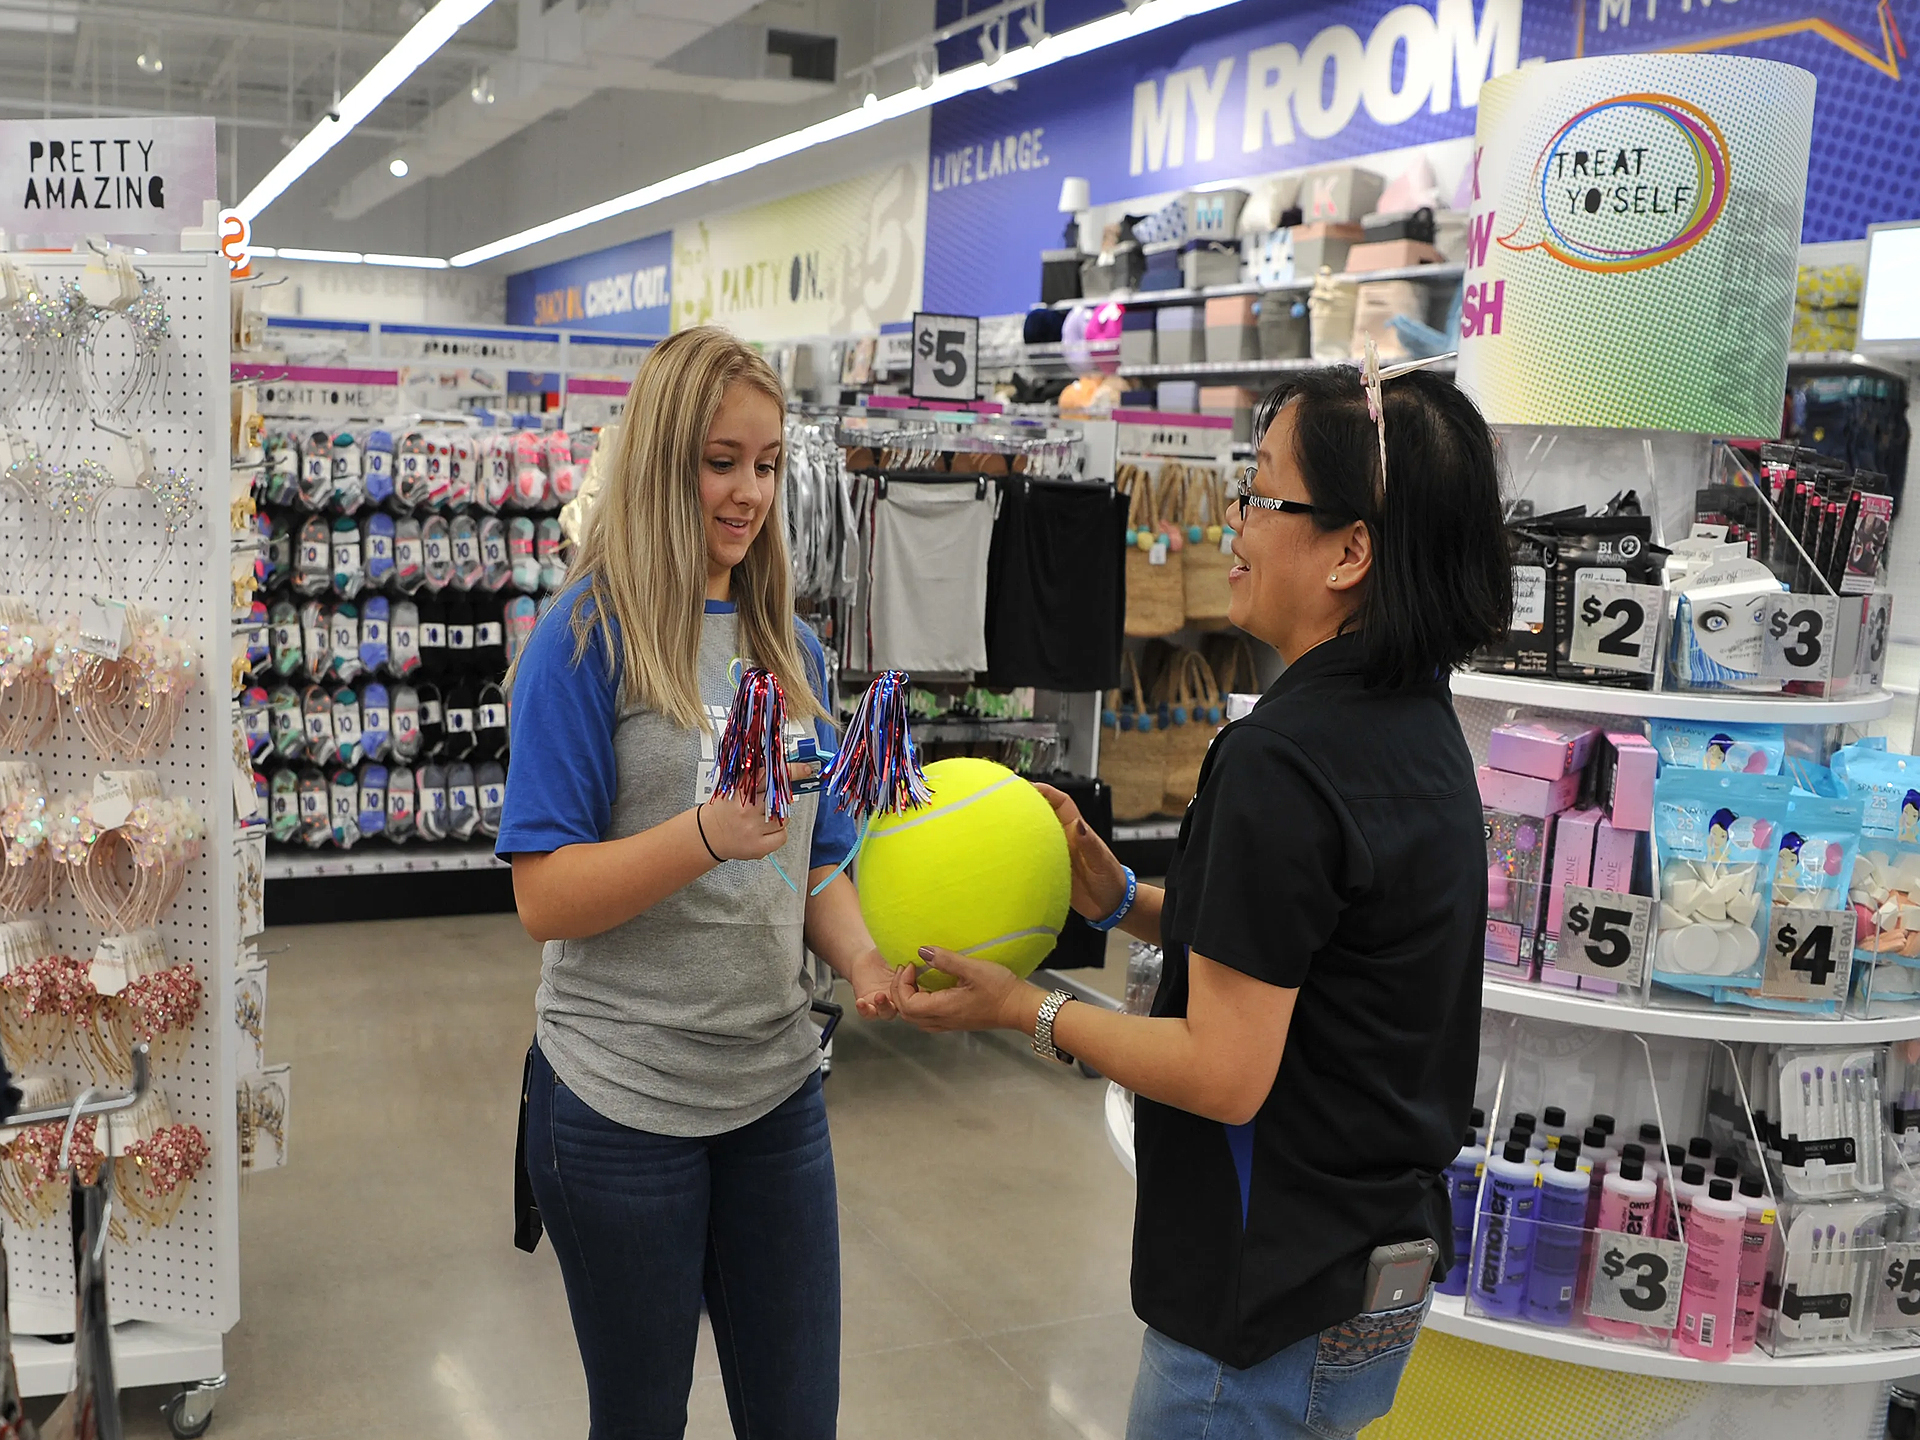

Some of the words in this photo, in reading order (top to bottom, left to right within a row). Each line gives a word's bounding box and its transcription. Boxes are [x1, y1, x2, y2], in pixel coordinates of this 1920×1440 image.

[1129, 58, 1236, 177] MY
[29, 139, 153, 173] PRETTY
[932, 146, 973, 191] LIVE
[975, 129, 1050, 181] LARGE.
[1555, 148, 1648, 179] TREAT
[24, 175, 164, 209] AMAZING
[1567, 186, 1691, 214] YO'SELF
[720, 257, 783, 312] PARTY
[918, 328, 967, 388] $5
[320, 389, 339, 405] TO
[309, 461, 320, 475] 10
[370, 456, 381, 471] 10
[404, 457, 416, 471] 10
[372, 539, 386, 557] 10
[426, 540, 440, 559] 10
[456, 540, 470, 559] 10
[487, 541, 501, 560] 10
[1581, 595, 1645, 657] $2
[1769, 608, 1824, 667] $3
[366, 792, 379, 808] 10
[485, 788, 499, 803] 10
[1872, 795, 1888, 810] 25
[1677, 817, 1694, 830] 25
[1568, 903, 1633, 968] $5
[1775, 923, 1836, 985] $4
[1482, 1186, 1507, 1294] remover
[1601, 1247, 1669, 1312] $3
